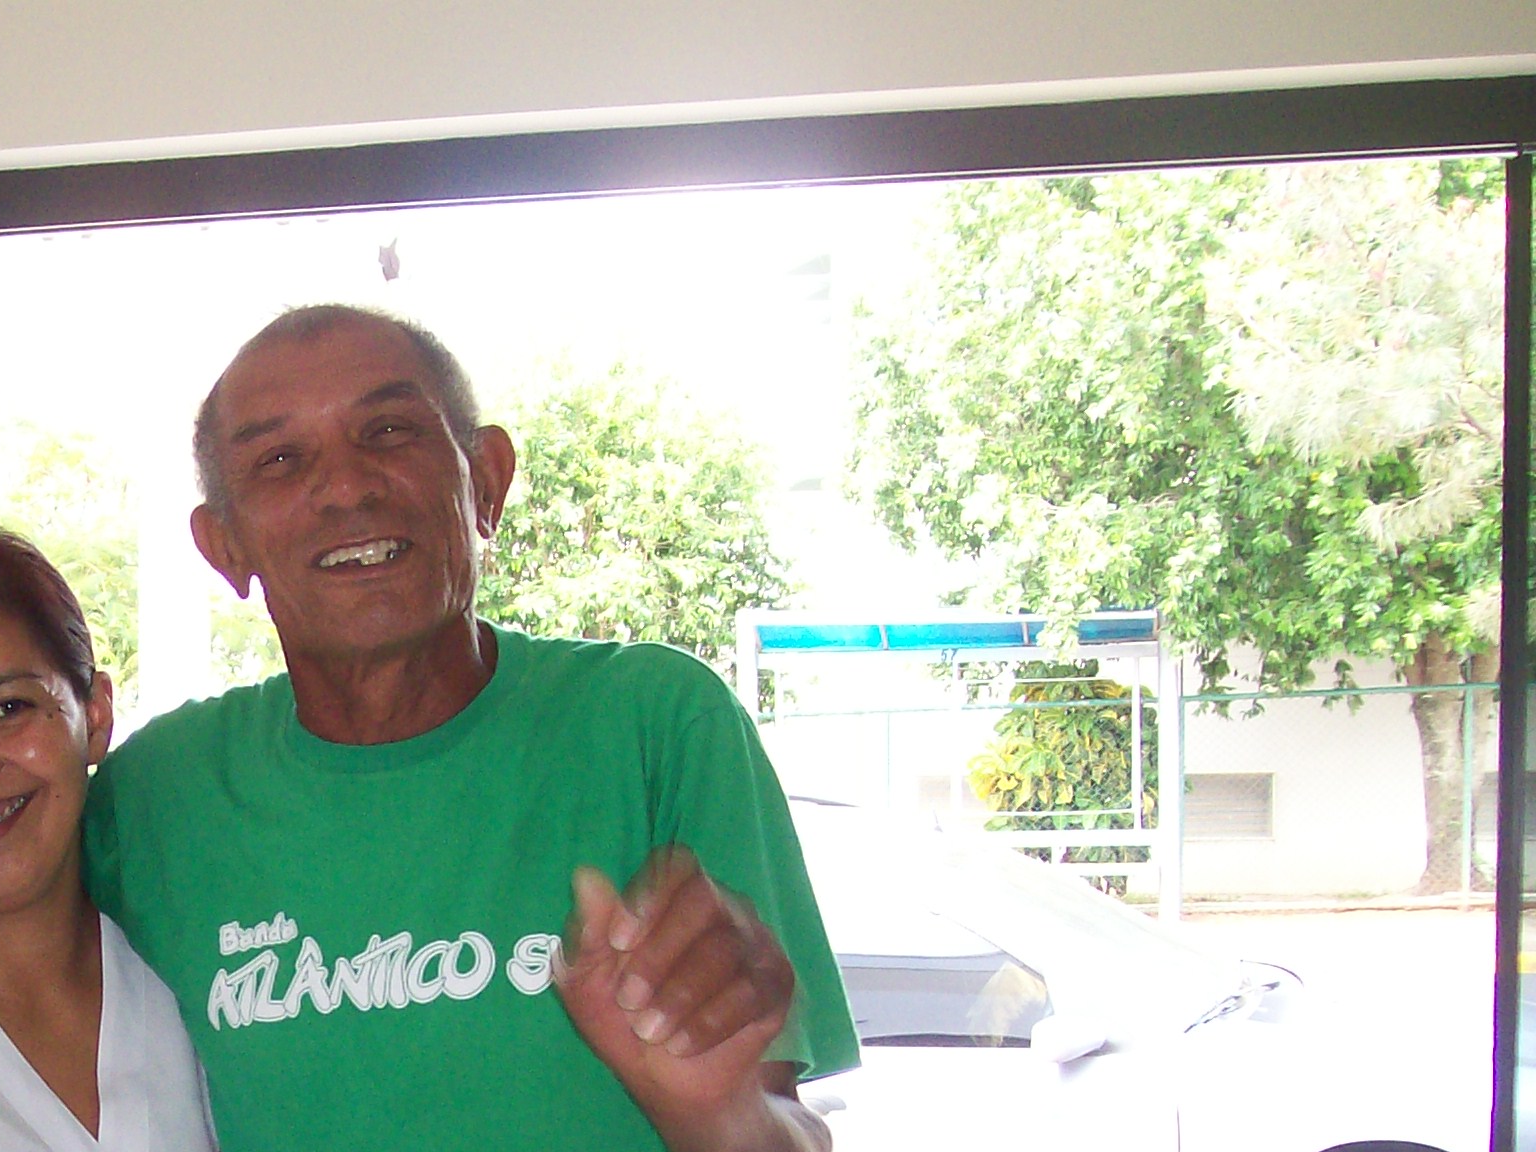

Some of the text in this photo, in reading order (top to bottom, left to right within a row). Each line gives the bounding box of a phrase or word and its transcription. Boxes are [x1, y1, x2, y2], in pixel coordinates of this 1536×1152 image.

[219, 911, 299, 956] Banda
[207, 931, 555, 1031] ATLÂNTICO S
